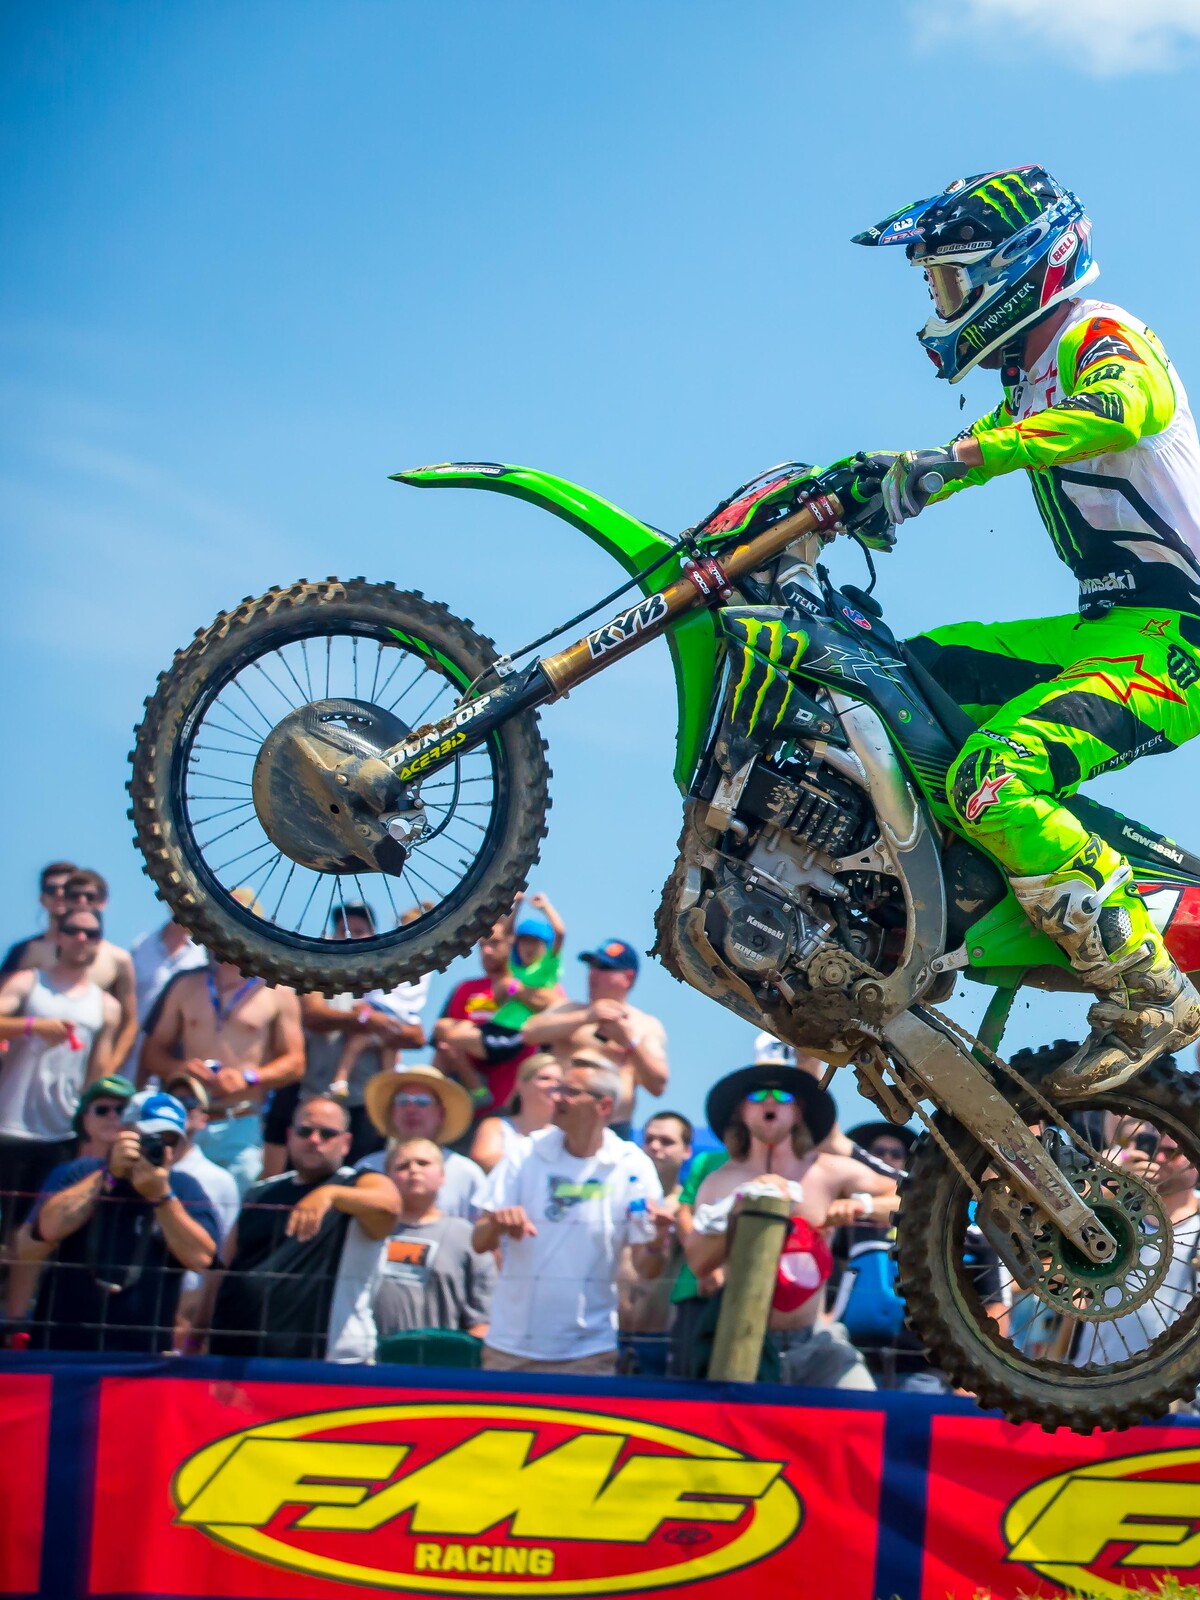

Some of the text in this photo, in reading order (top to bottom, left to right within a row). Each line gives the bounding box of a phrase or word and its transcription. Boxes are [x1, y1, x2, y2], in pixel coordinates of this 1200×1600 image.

[1052, 237, 1075, 262] BELL
[979, 282, 1035, 333] MONSTER
[587, 593, 669, 660] KYB
[1109, 734, 1163, 768] MONSTER
[1121, 825, 1184, 865] Kawasaki
[746, 915, 785, 940] Kawasaki
[172, 1428, 789, 1544] FMF
[414, 1541, 556, 1577] RACING
